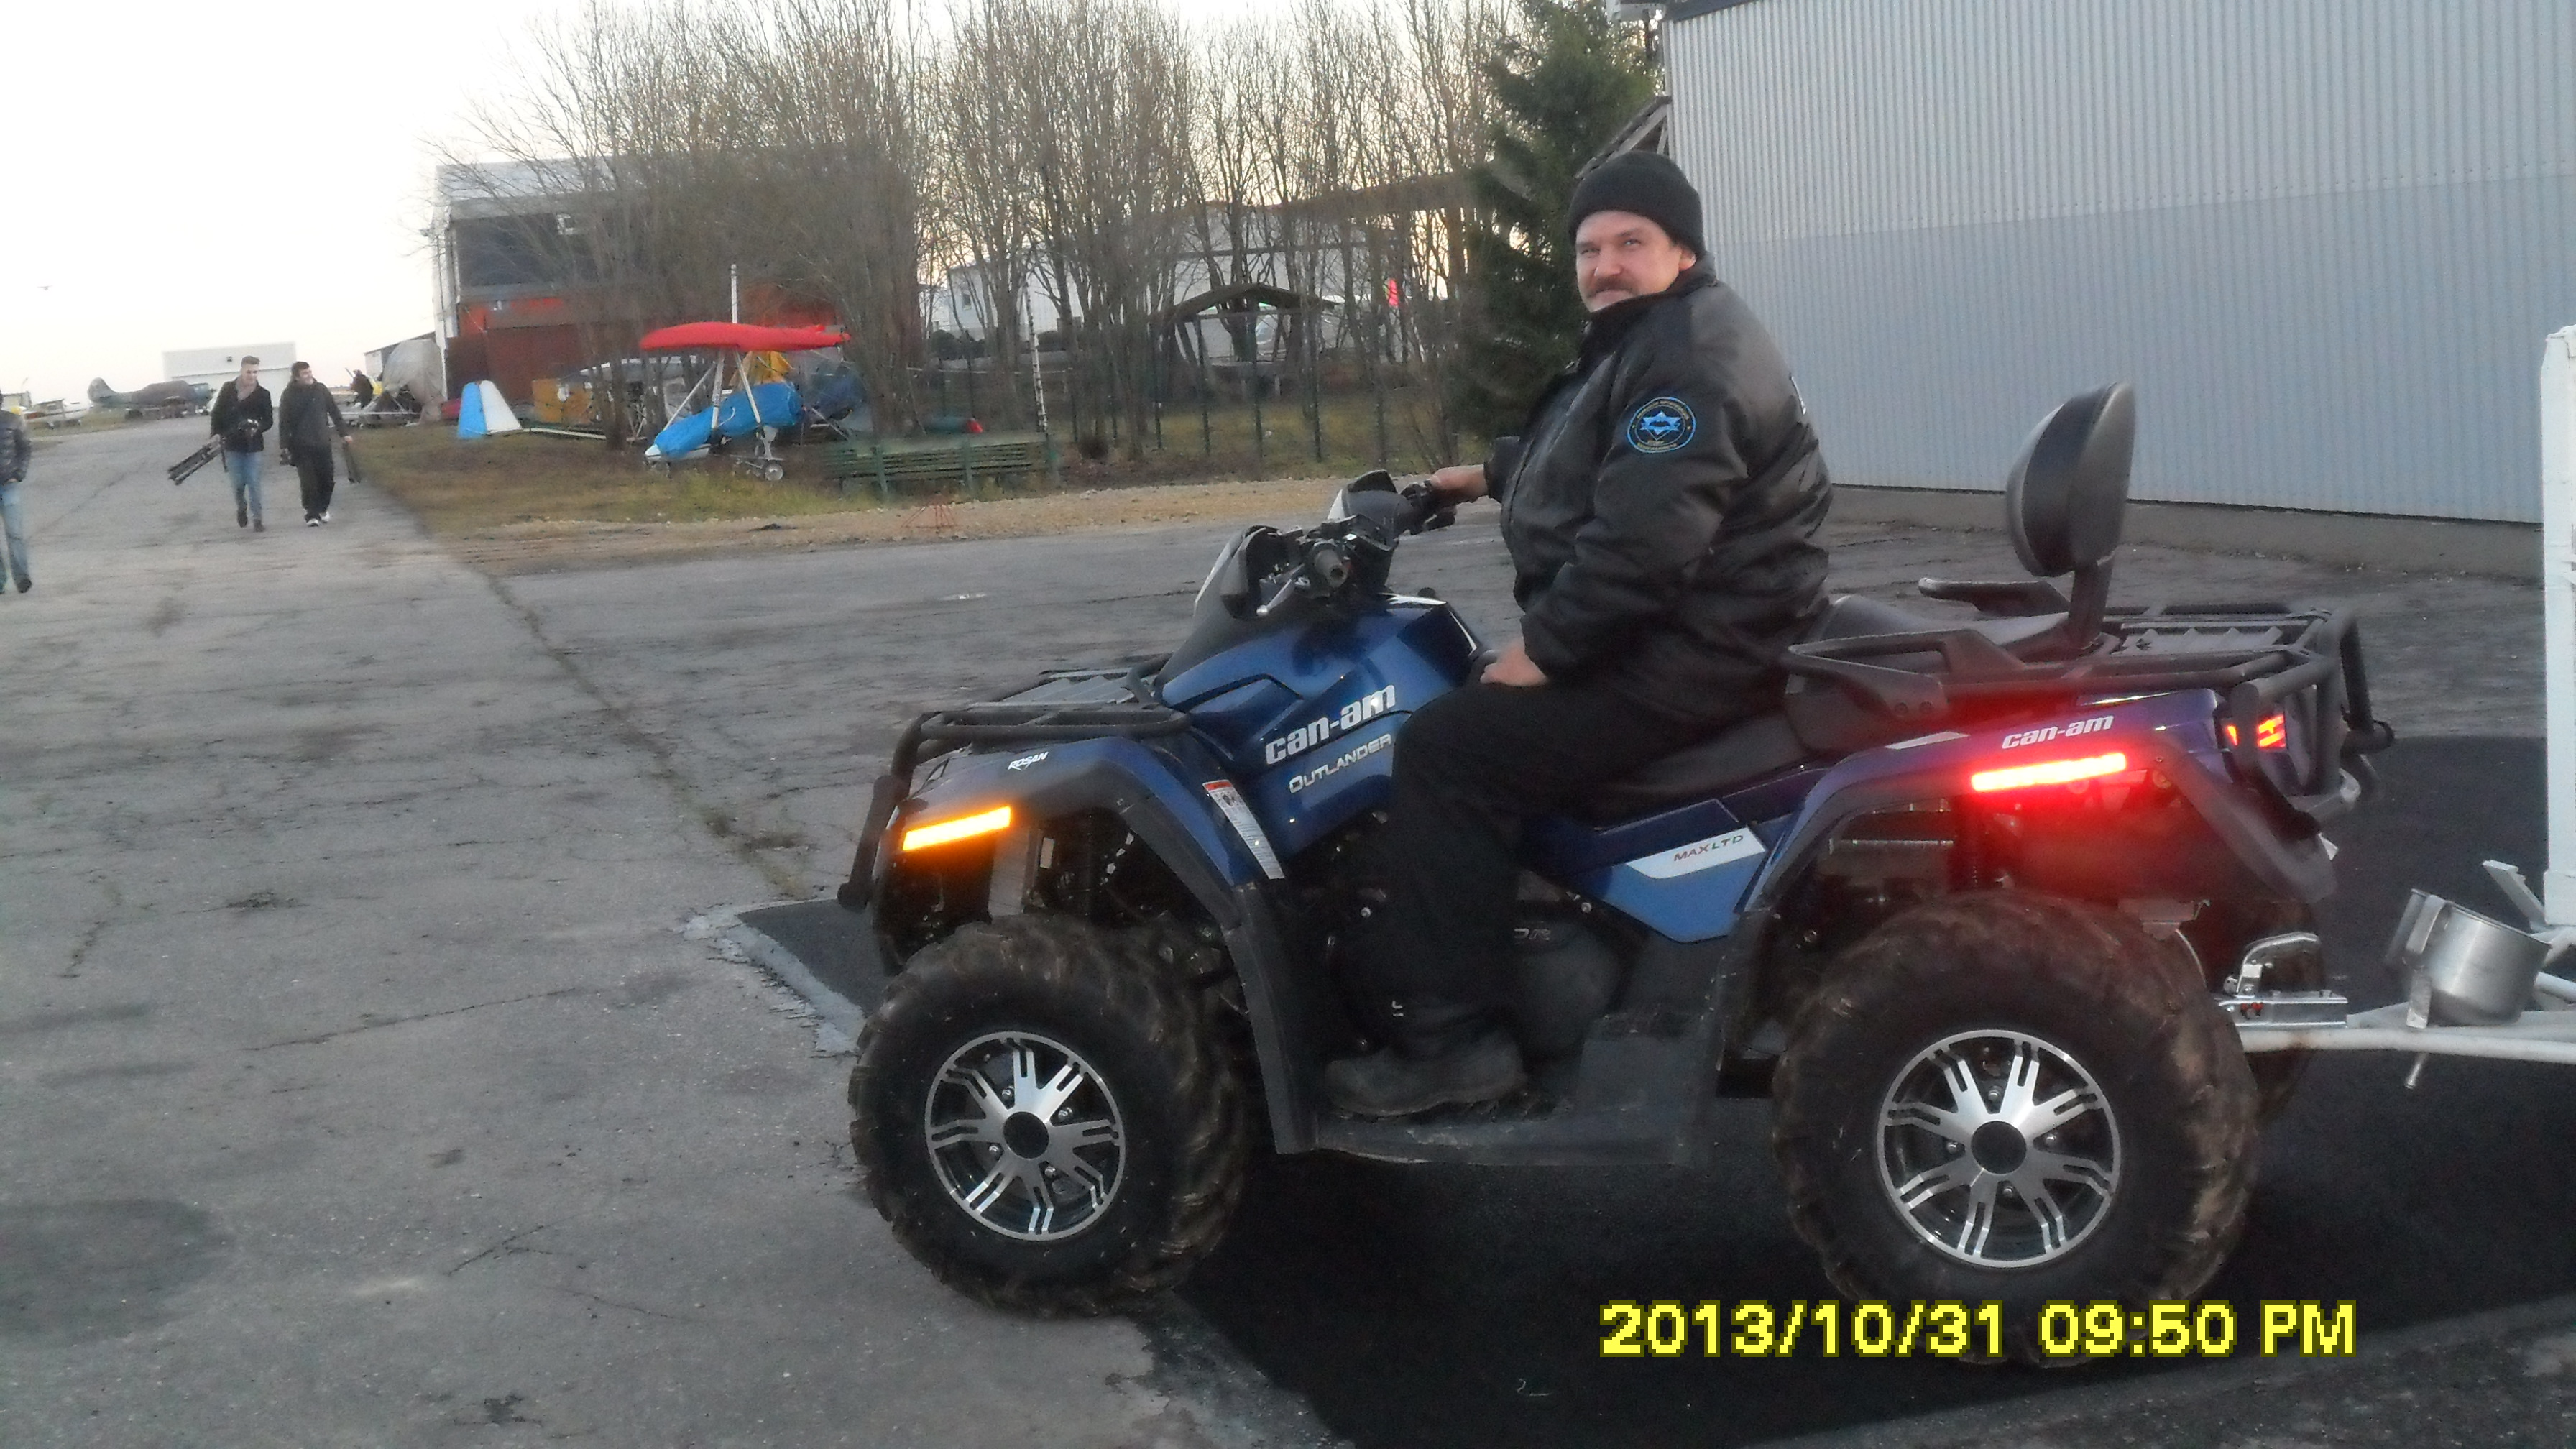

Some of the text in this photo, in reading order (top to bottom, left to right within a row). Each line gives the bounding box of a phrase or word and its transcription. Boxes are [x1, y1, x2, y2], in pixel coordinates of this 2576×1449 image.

[1266, 684, 1396, 765] can-am
[2001, 715, 2115, 749] can-am
[1289, 733, 1392, 794] OUTLANDER
